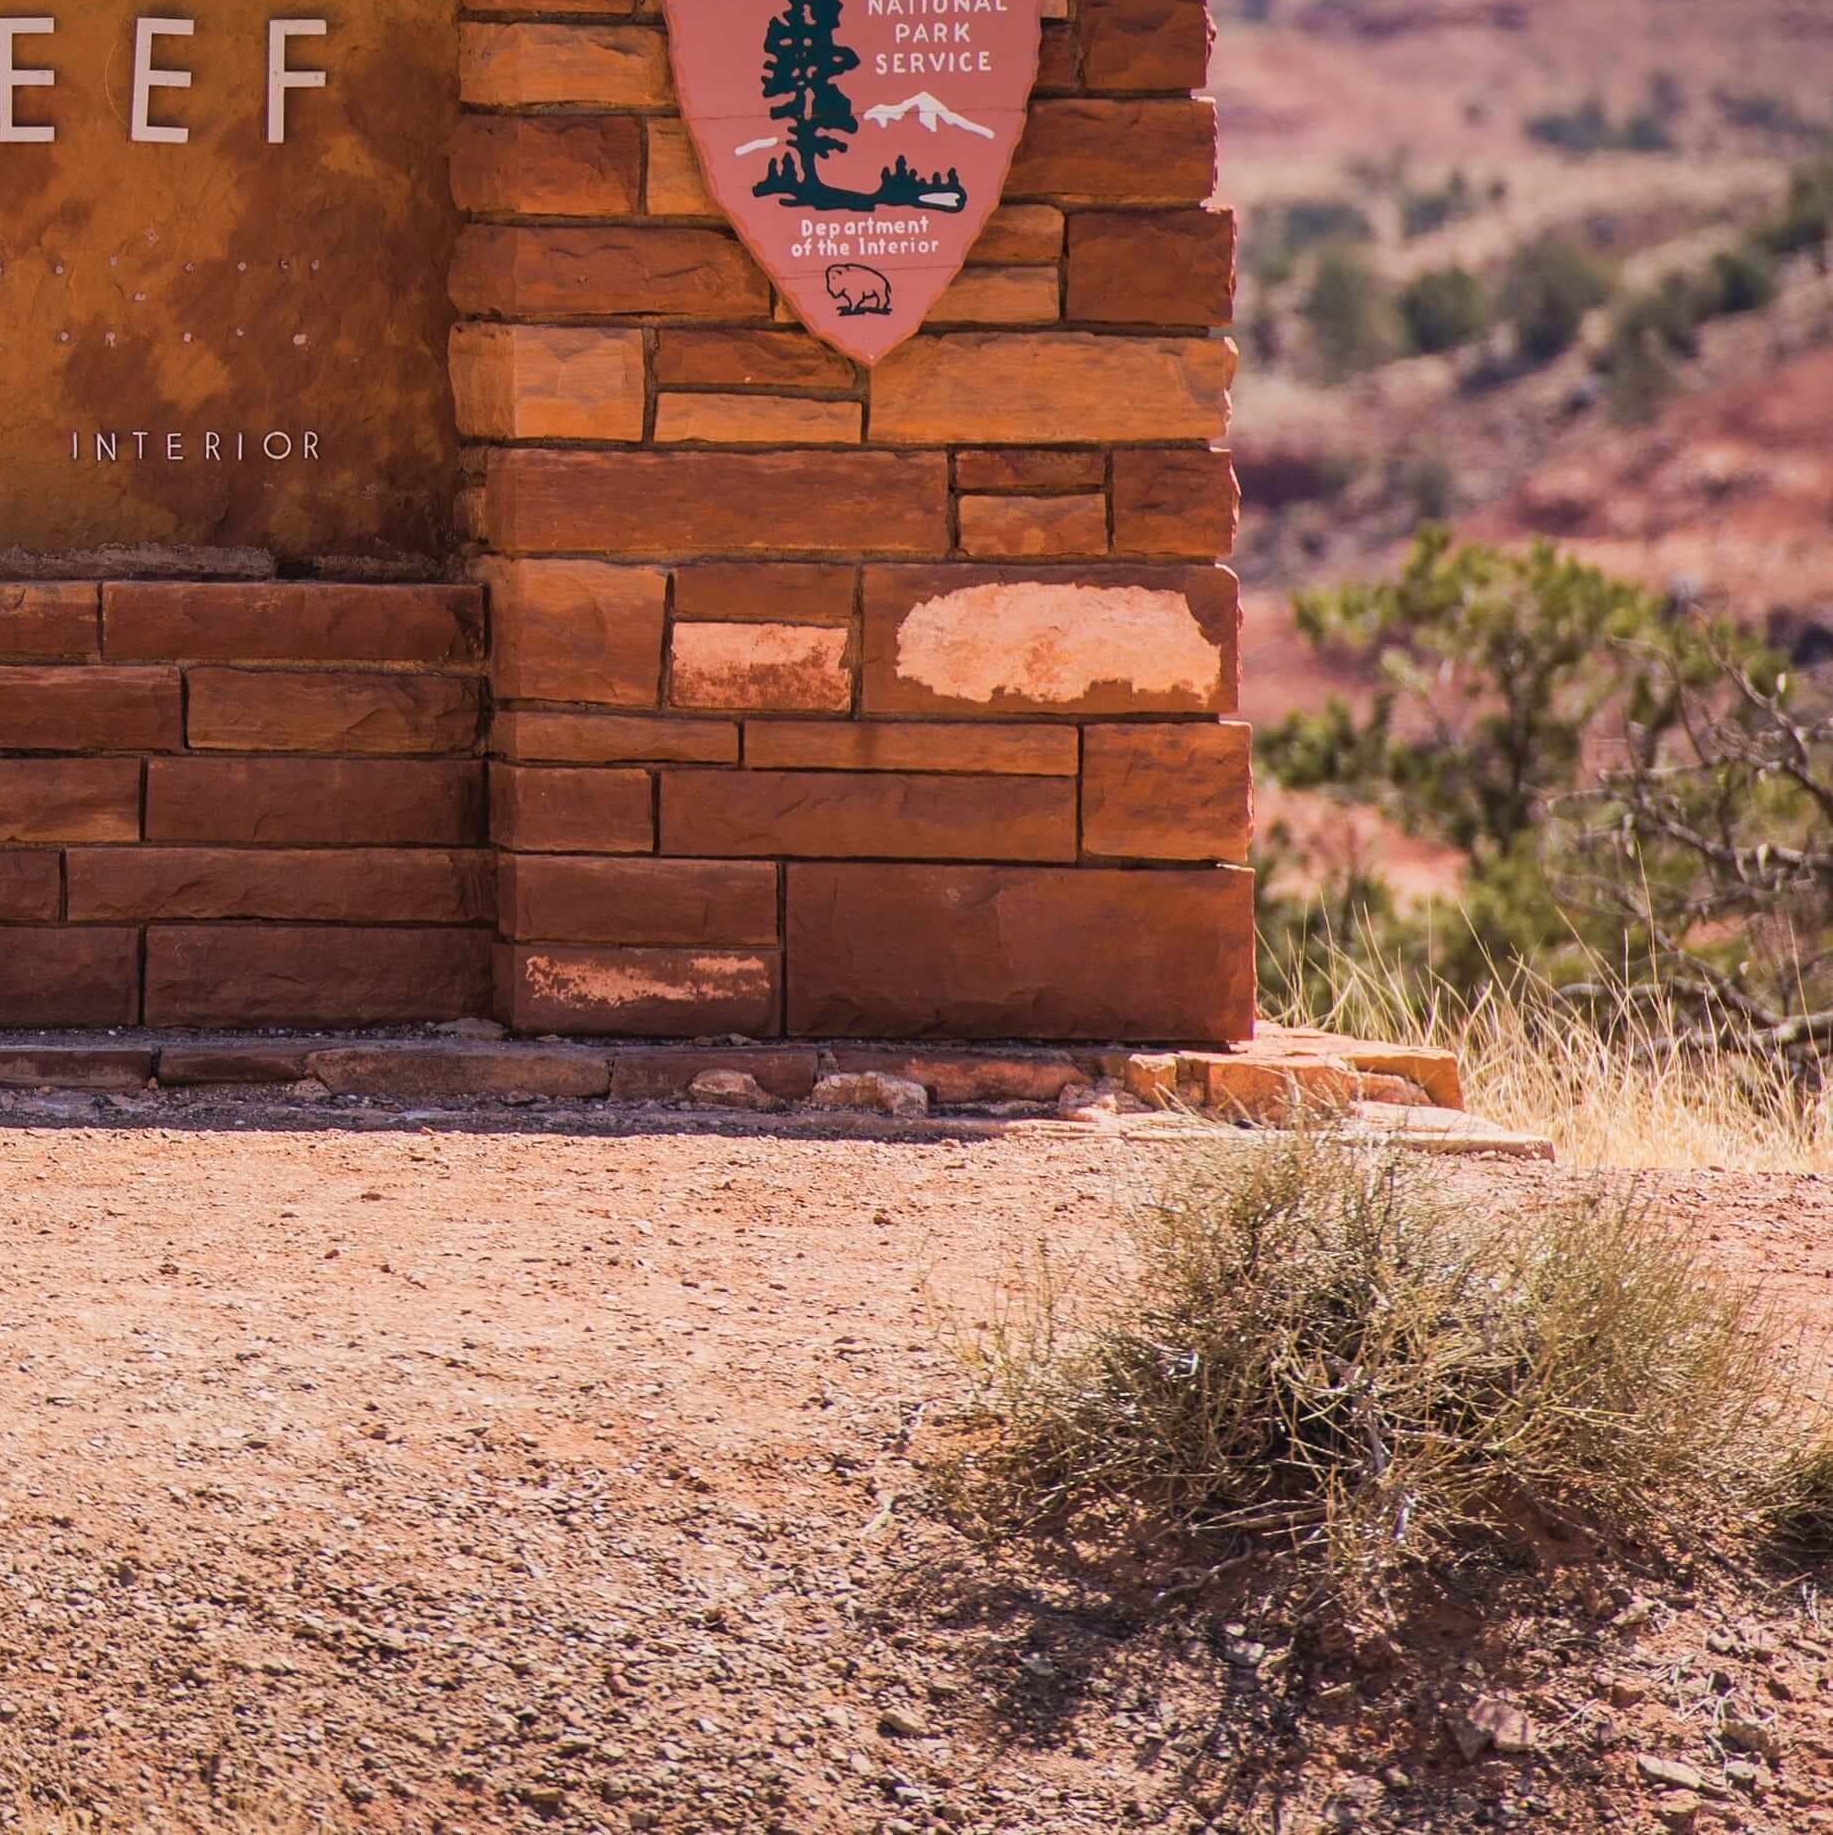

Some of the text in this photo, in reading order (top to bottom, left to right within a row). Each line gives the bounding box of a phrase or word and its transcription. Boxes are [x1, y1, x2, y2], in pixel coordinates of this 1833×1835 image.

[894, 22, 971, 44] PARK
[875, 51, 993, 75] SERVICE
[801, 216, 929, 239] Department
[790, 237, 939, 258] of the Interior
[71, 430, 321, 461] INTERIOR
